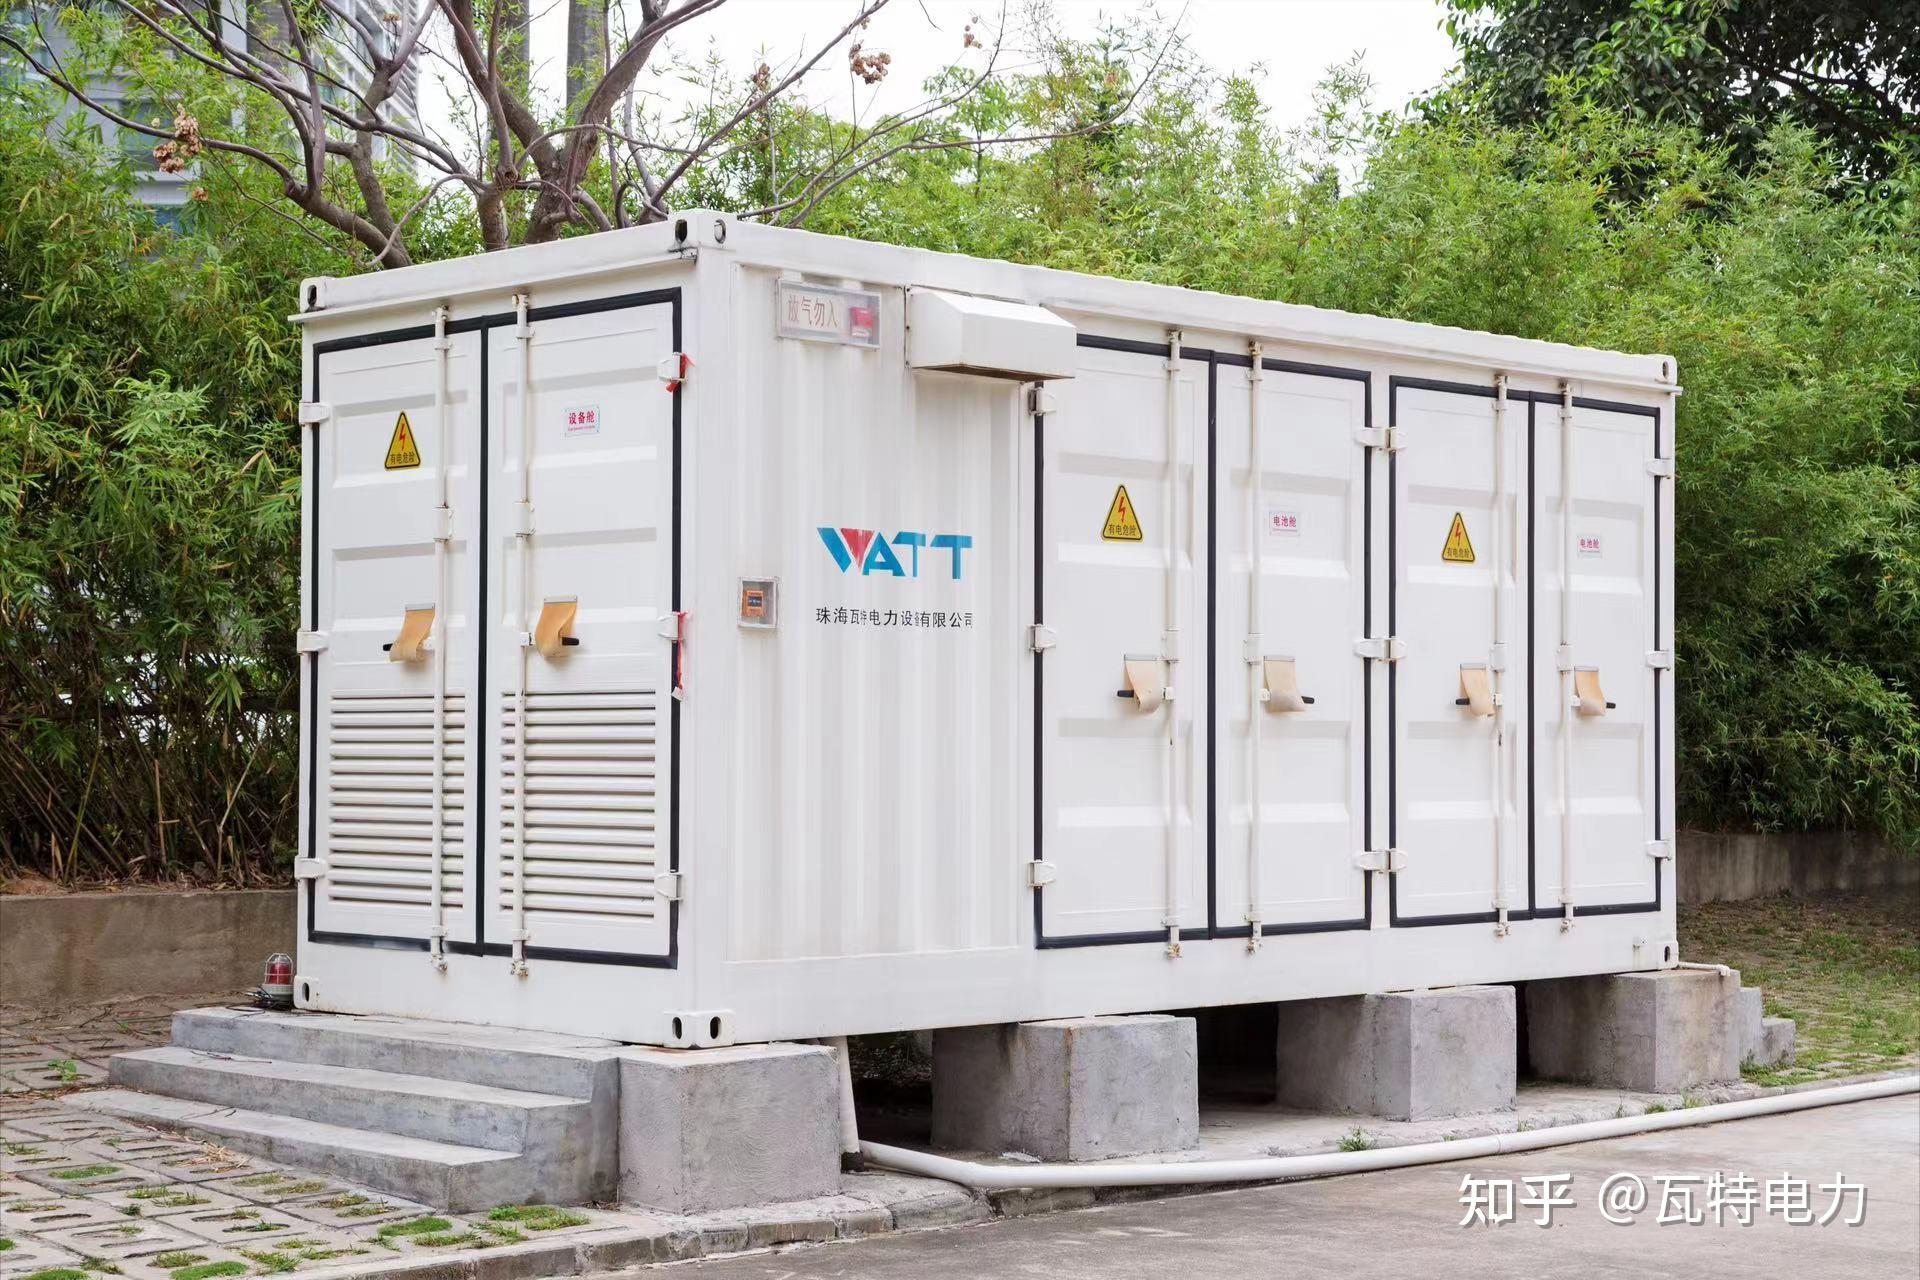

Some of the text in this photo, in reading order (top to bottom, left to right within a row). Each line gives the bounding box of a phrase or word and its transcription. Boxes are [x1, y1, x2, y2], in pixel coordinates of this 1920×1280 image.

[569, 410, 595, 424] 设备舱
[390, 452, 415, 464] 有电危险
[1273, 515, 1296, 527] 电池舱
[1108, 524, 1136, 536] 有电危险
[816, 527, 973, 579] WATT
